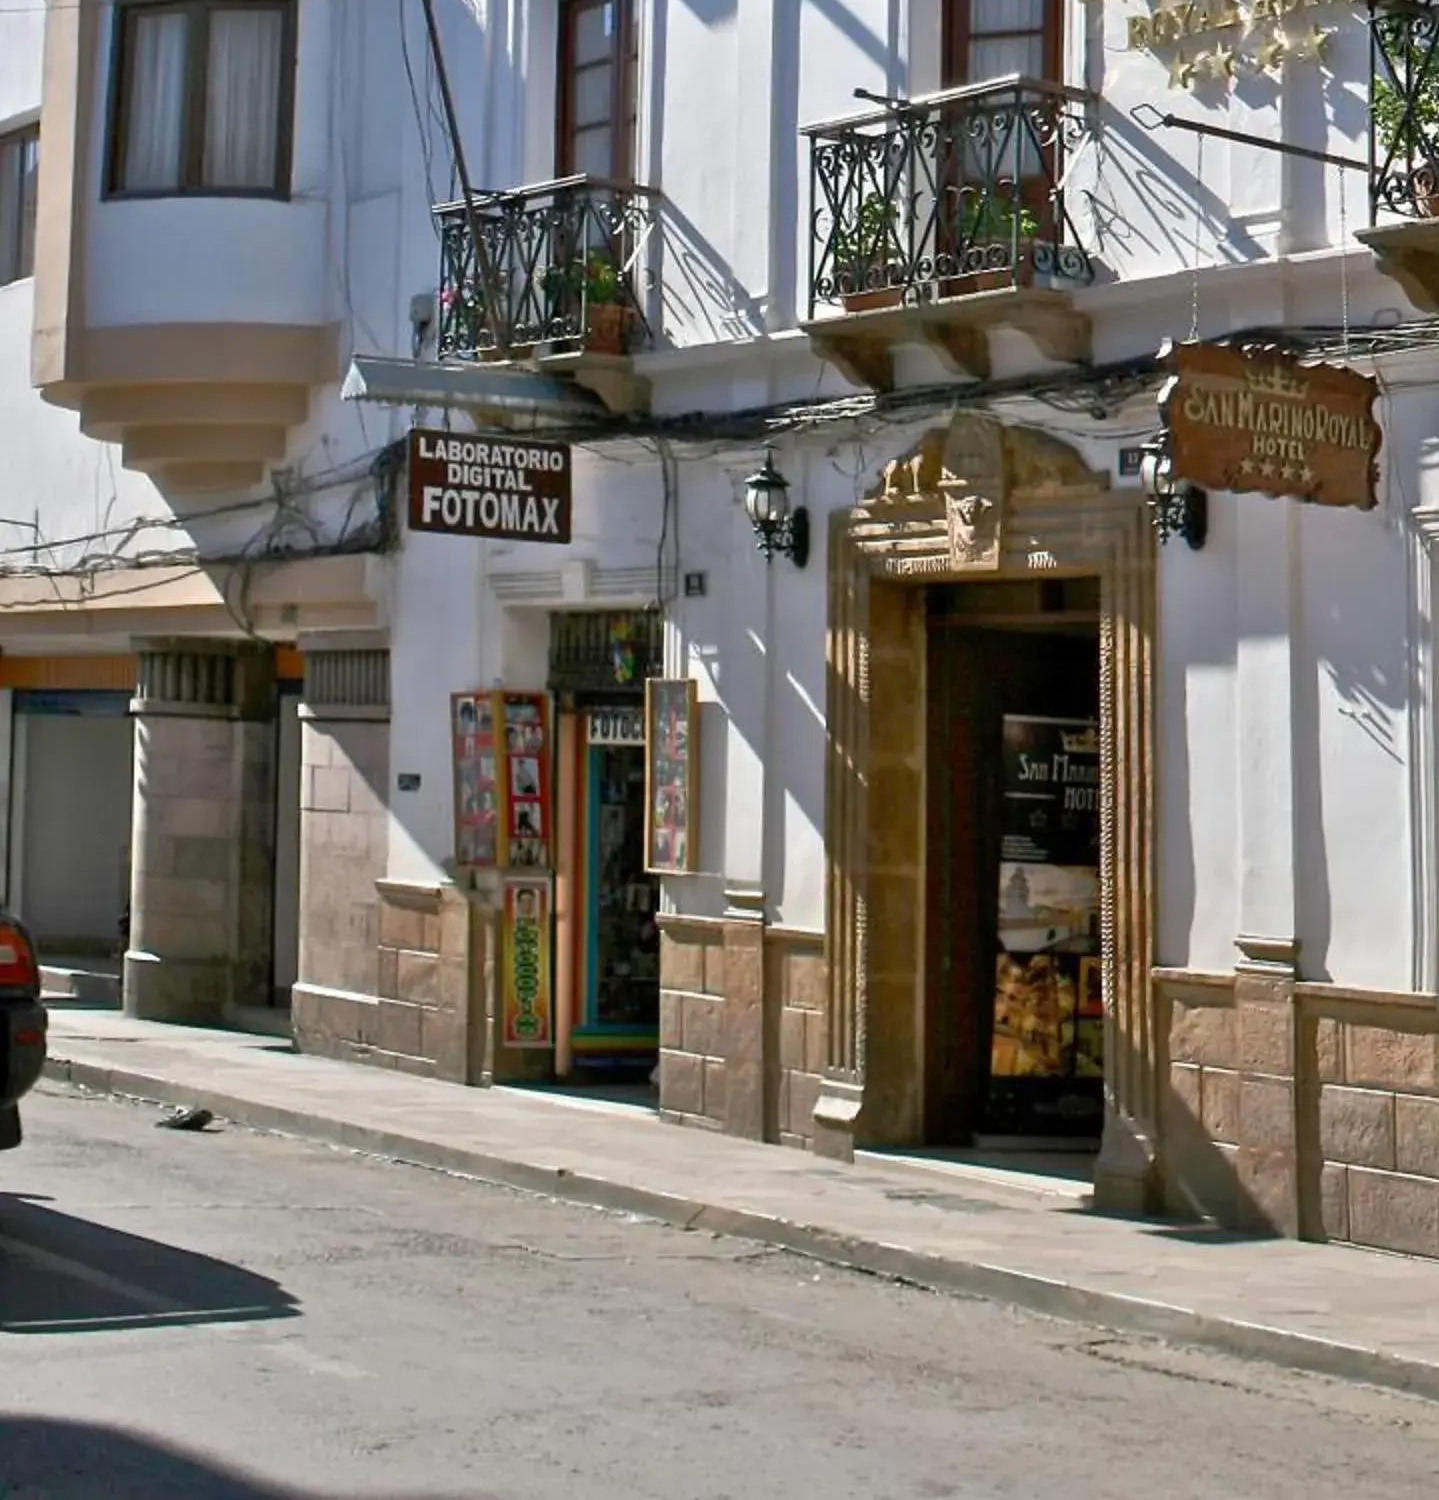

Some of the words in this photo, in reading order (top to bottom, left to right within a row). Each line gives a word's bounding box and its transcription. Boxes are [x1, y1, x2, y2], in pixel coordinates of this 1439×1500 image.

[1315, 405, 1371, 450] ROYAL
[419, 437, 563, 471] LABORATORIO
[1253, 437, 1306, 461] HOTEL
[447, 463, 533, 492] DIGITAL
[421, 485, 560, 535] FOTOMAX
